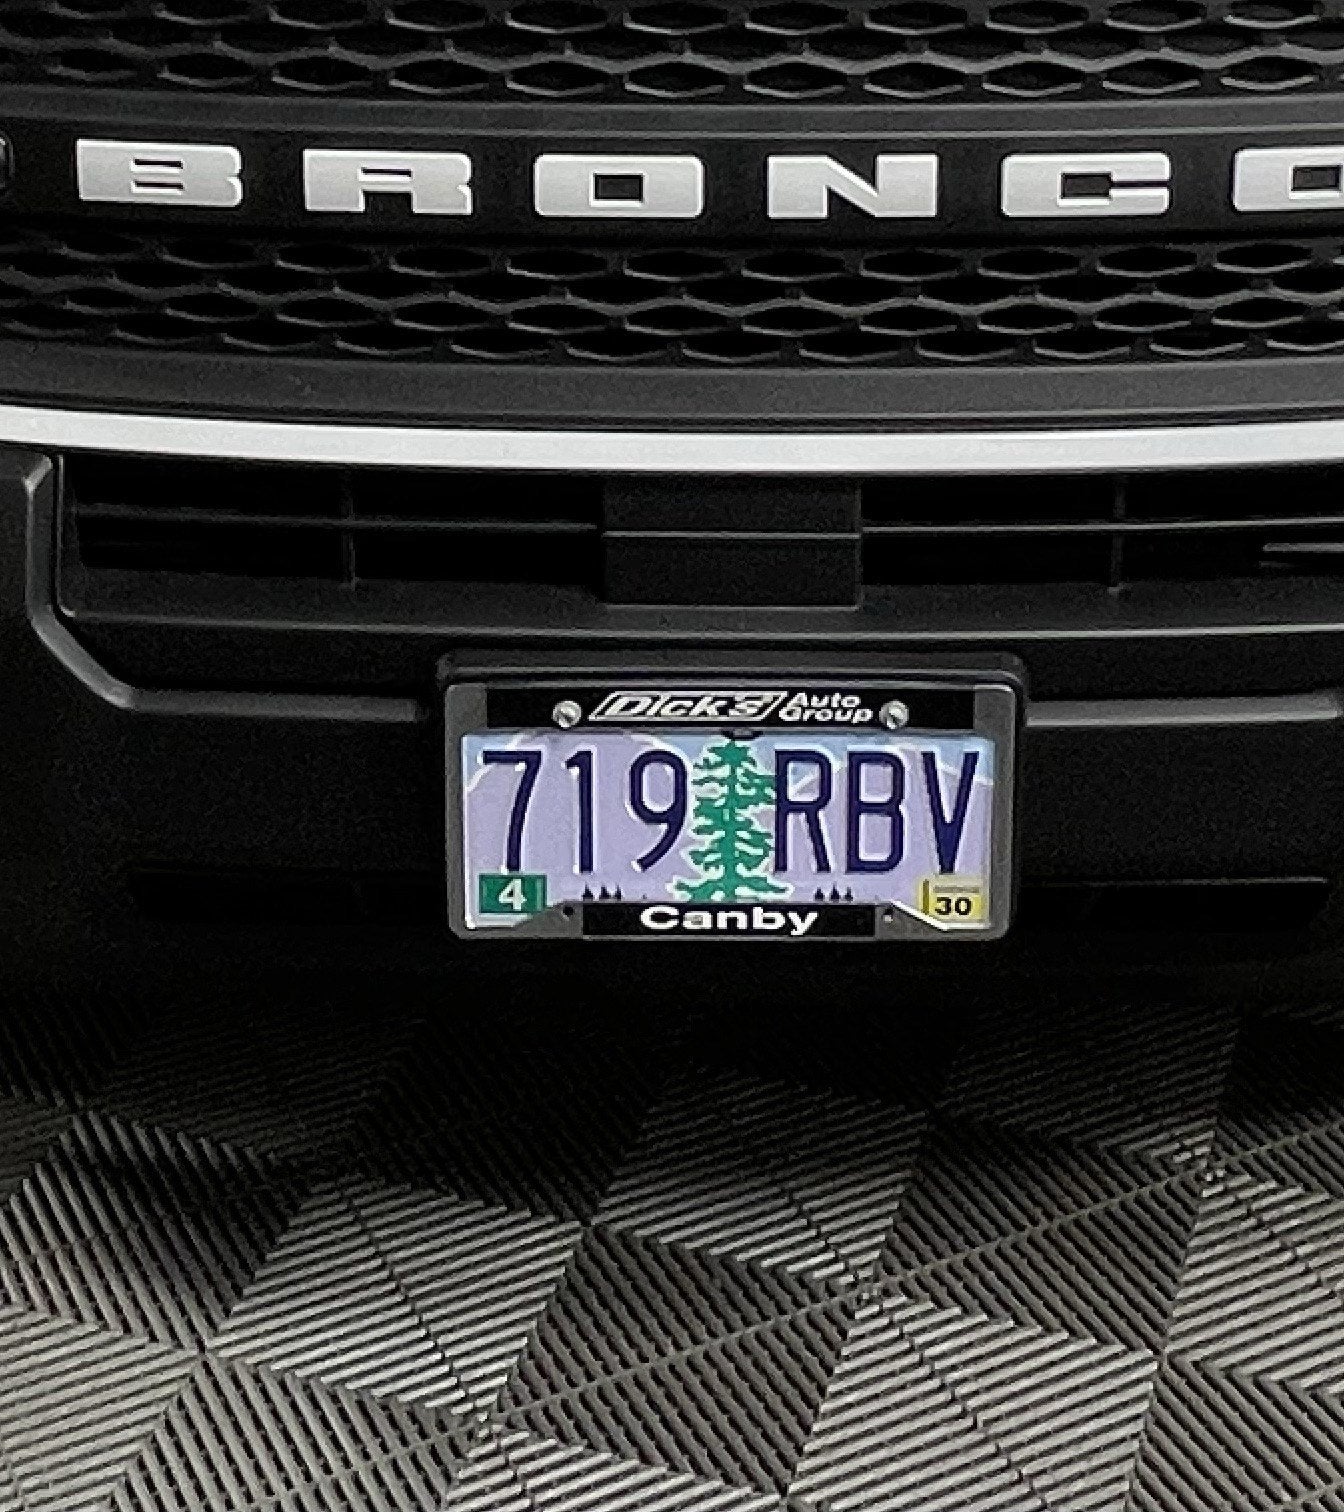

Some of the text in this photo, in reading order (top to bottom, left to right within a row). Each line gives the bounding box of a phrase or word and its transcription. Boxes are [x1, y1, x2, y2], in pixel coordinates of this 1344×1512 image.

[787, 692, 861, 708] Auto
[778, 707, 873, 724] Group
[481, 749, 980, 875] 719 RBV
[497, 878, 527, 911] 4
[935, 896, 972, 916] 30
[640, 903, 819, 935] Canby
